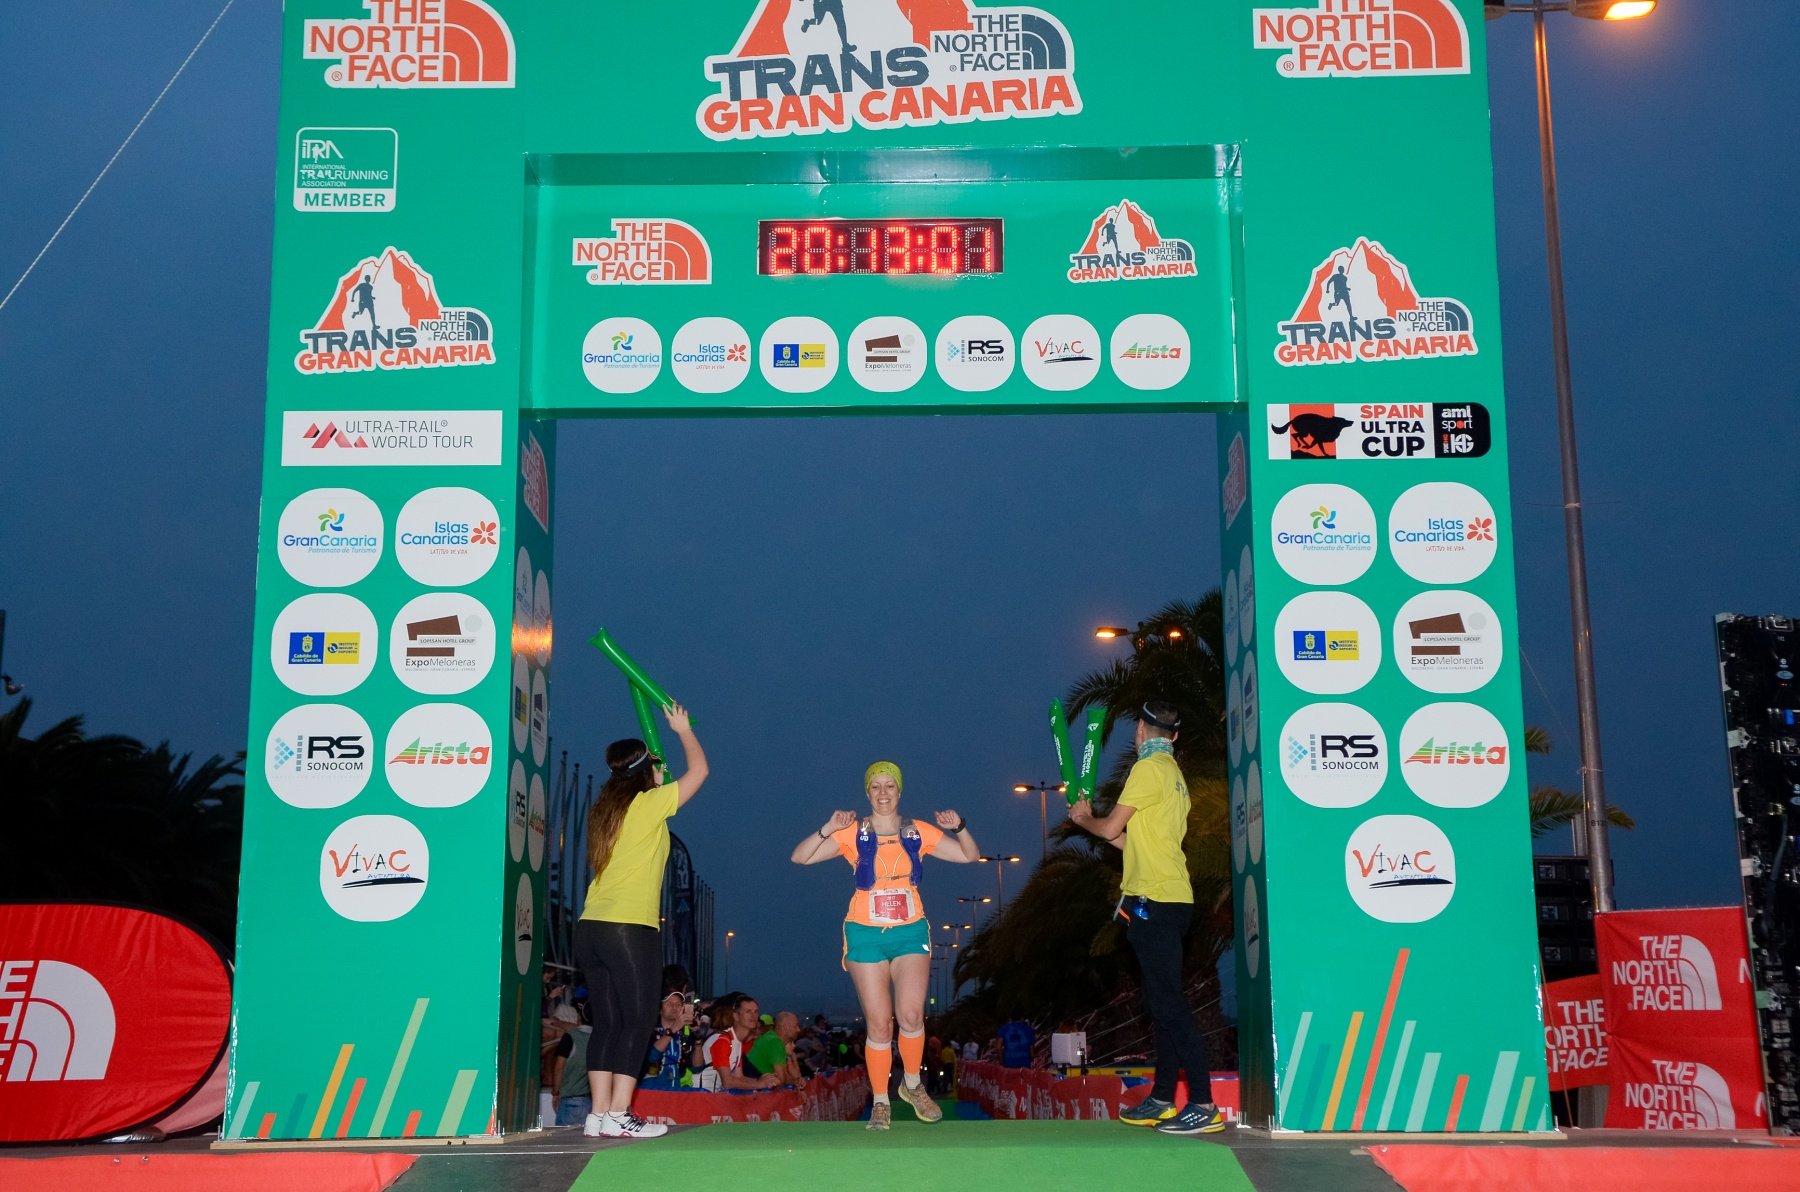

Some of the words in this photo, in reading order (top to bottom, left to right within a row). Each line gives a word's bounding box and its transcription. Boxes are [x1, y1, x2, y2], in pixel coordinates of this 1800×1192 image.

[371, 0, 440, 24] THE
[972, 14, 1019, 33] THE
[1260, 14, 1390, 42] NORTH
[310, 25, 439, 53] NORTH
[934, 33, 1020, 53] NORTH
[960, 52, 1020, 72] FACE
[1299, 43, 1391, 71] FACE
[347, 54, 439, 82] FACE
[712, 46, 929, 101] TRANS
[703, 93, 844, 133] GRAN
[858, 75, 1074, 123] CANARIA
[304, 193, 386, 207] MEMBER
[616, 223, 662, 241] THE
[577, 242, 662, 261] NORTH
[771, 226, 992, 274] 20:13:01
[1072, 251, 1146, 269] TRANS
[602, 262, 661, 281] FACE
[1069, 267, 1118, 280] GRAN
[1122, 263, 1194, 277] CANARIA
[441, 311, 465, 320] THE
[1418, 302, 1443, 311] THE
[420, 321, 465, 331] NORTH
[1398, 312, 1444, 322] NORTH
[1413, 322, 1444, 331] FACE
[304, 327, 418, 354] TRANS
[433, 332, 465, 341] FACE
[1282, 318, 1396, 346] TRANS
[299, 350, 372, 370] GRAN
[380, 343, 491, 367] CANARIA
[673, 352, 725, 362] Canarias
[699, 344, 725, 353] Islas
[968, 340, 1004, 355] RS
[1120, 342, 1181, 359] Arista
[1278, 341, 1352, 363] GRAN
[1359, 334, 1473, 358] CANARIA
[584, 352, 660, 363] GranCanaria
[1360, 405, 1424, 419] SPAIN
[1361, 421, 1425, 433] ULTRA
[372, 435, 428, 448] WORLD
[433, 435, 473, 448] TOUR
[1361, 436, 1426, 457] CUP
[434, 521, 469, 533] Islas
[1428, 518, 1464, 530] Islas
[283, 535, 377, 547] GranCanaria
[401, 533, 469, 545] Canarias
[1277, 532, 1371, 544] GranCanaria
[1395, 529, 1464, 542] Canarias
[405, 658, 476, 667] ExpoMeloneras
[1411, 656, 1484, 666] ExpoMeloneras
[308, 735, 365, 759] RS
[388, 737, 490, 765] Arista
[1321, 735, 1379, 758] RS
[1404, 736, 1507, 765] Arista
[307, 762, 363, 771] SONOCOM
[1322, 761, 1379, 770] SONOCOM
[1640, 935, 1680, 959] THE
[1613, 960, 1680, 985] NORTH
[1633, 985, 1683, 1011] FACE
[1557, 999, 1605, 1024] THE
[1552, 1047, 1609, 1073] FACE
[1651, 1060, 1696, 1085] THE
[1625, 1083, 1695, 1112] NORTH
[1645, 1110, 1698, 1130] FACE
